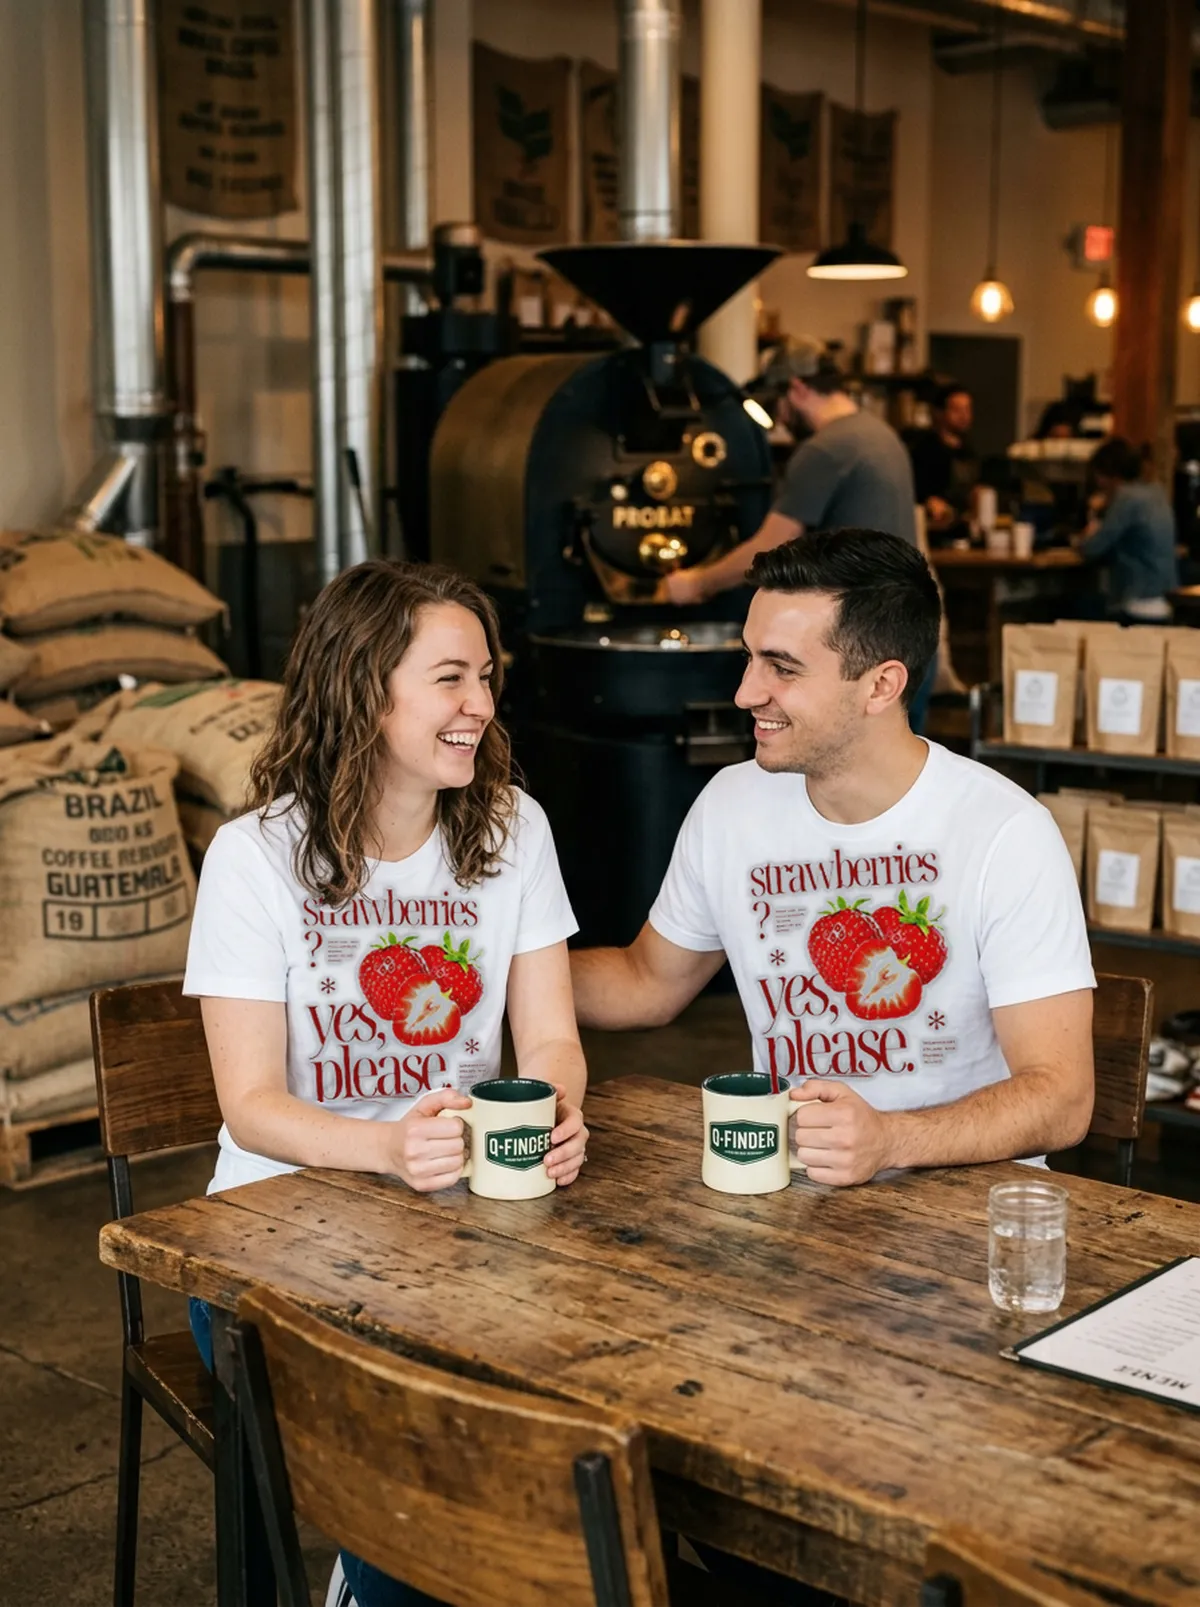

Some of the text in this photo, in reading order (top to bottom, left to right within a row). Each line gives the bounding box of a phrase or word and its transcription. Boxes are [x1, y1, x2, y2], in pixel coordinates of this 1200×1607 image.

[65, 784, 163, 819] BRAZIL
[42, 847, 112, 869] COFFEE
[47, 855, 182, 898] GUATEMALA
[750, 844, 939, 897] strawberries
[56, 910, 84, 932] 19
[752, 901, 771, 940] ?
[304, 931, 323, 968] ?
[758, 974, 840, 1035] yes,
[308, 1002, 387, 1060] yes,
[766, 1019, 914, 1095] please.
